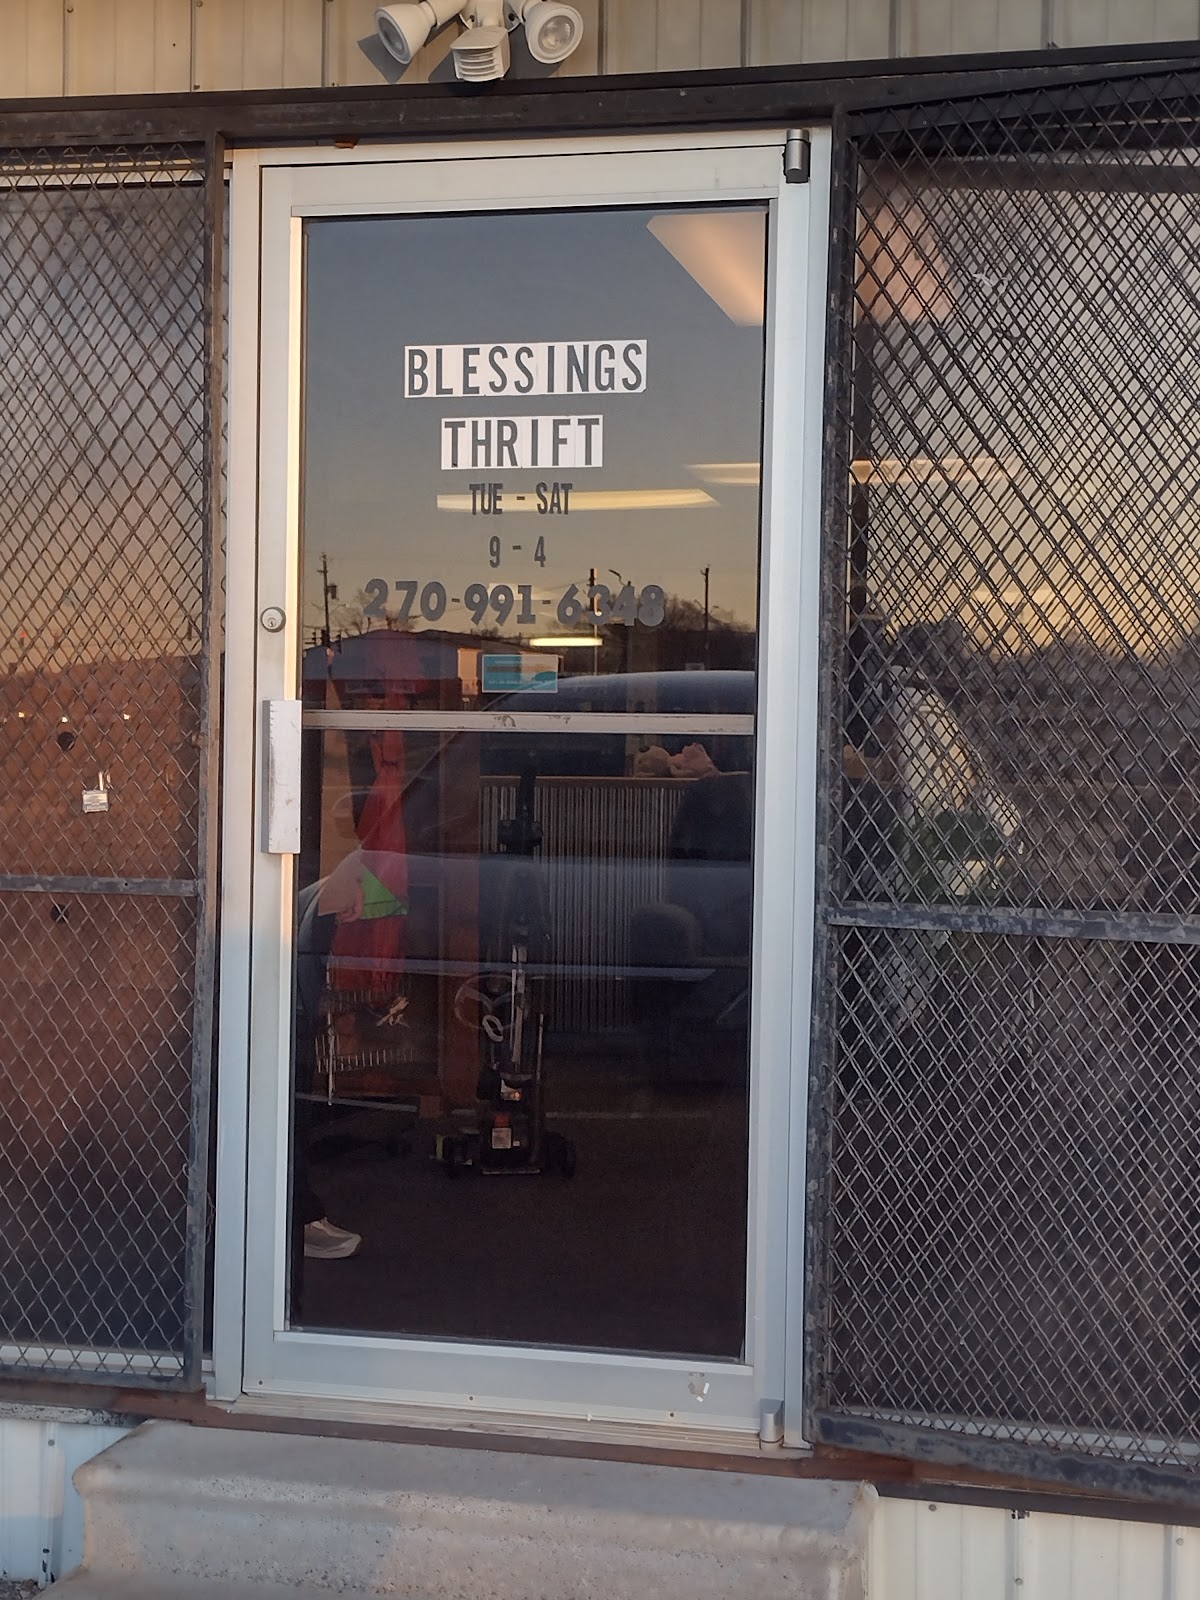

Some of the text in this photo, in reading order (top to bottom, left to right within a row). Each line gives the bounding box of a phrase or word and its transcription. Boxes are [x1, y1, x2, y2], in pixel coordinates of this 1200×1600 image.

[408, 343, 643, 397] BLESSINGS
[444, 417, 600, 468] THRIFT
[468, 483, 504, 515] TUE
[535, 482, 573, 515] SAT
[489, 536, 500, 568] 9
[534, 536, 546, 567] 4
[362, 578, 665, 627] 270-991-6348
